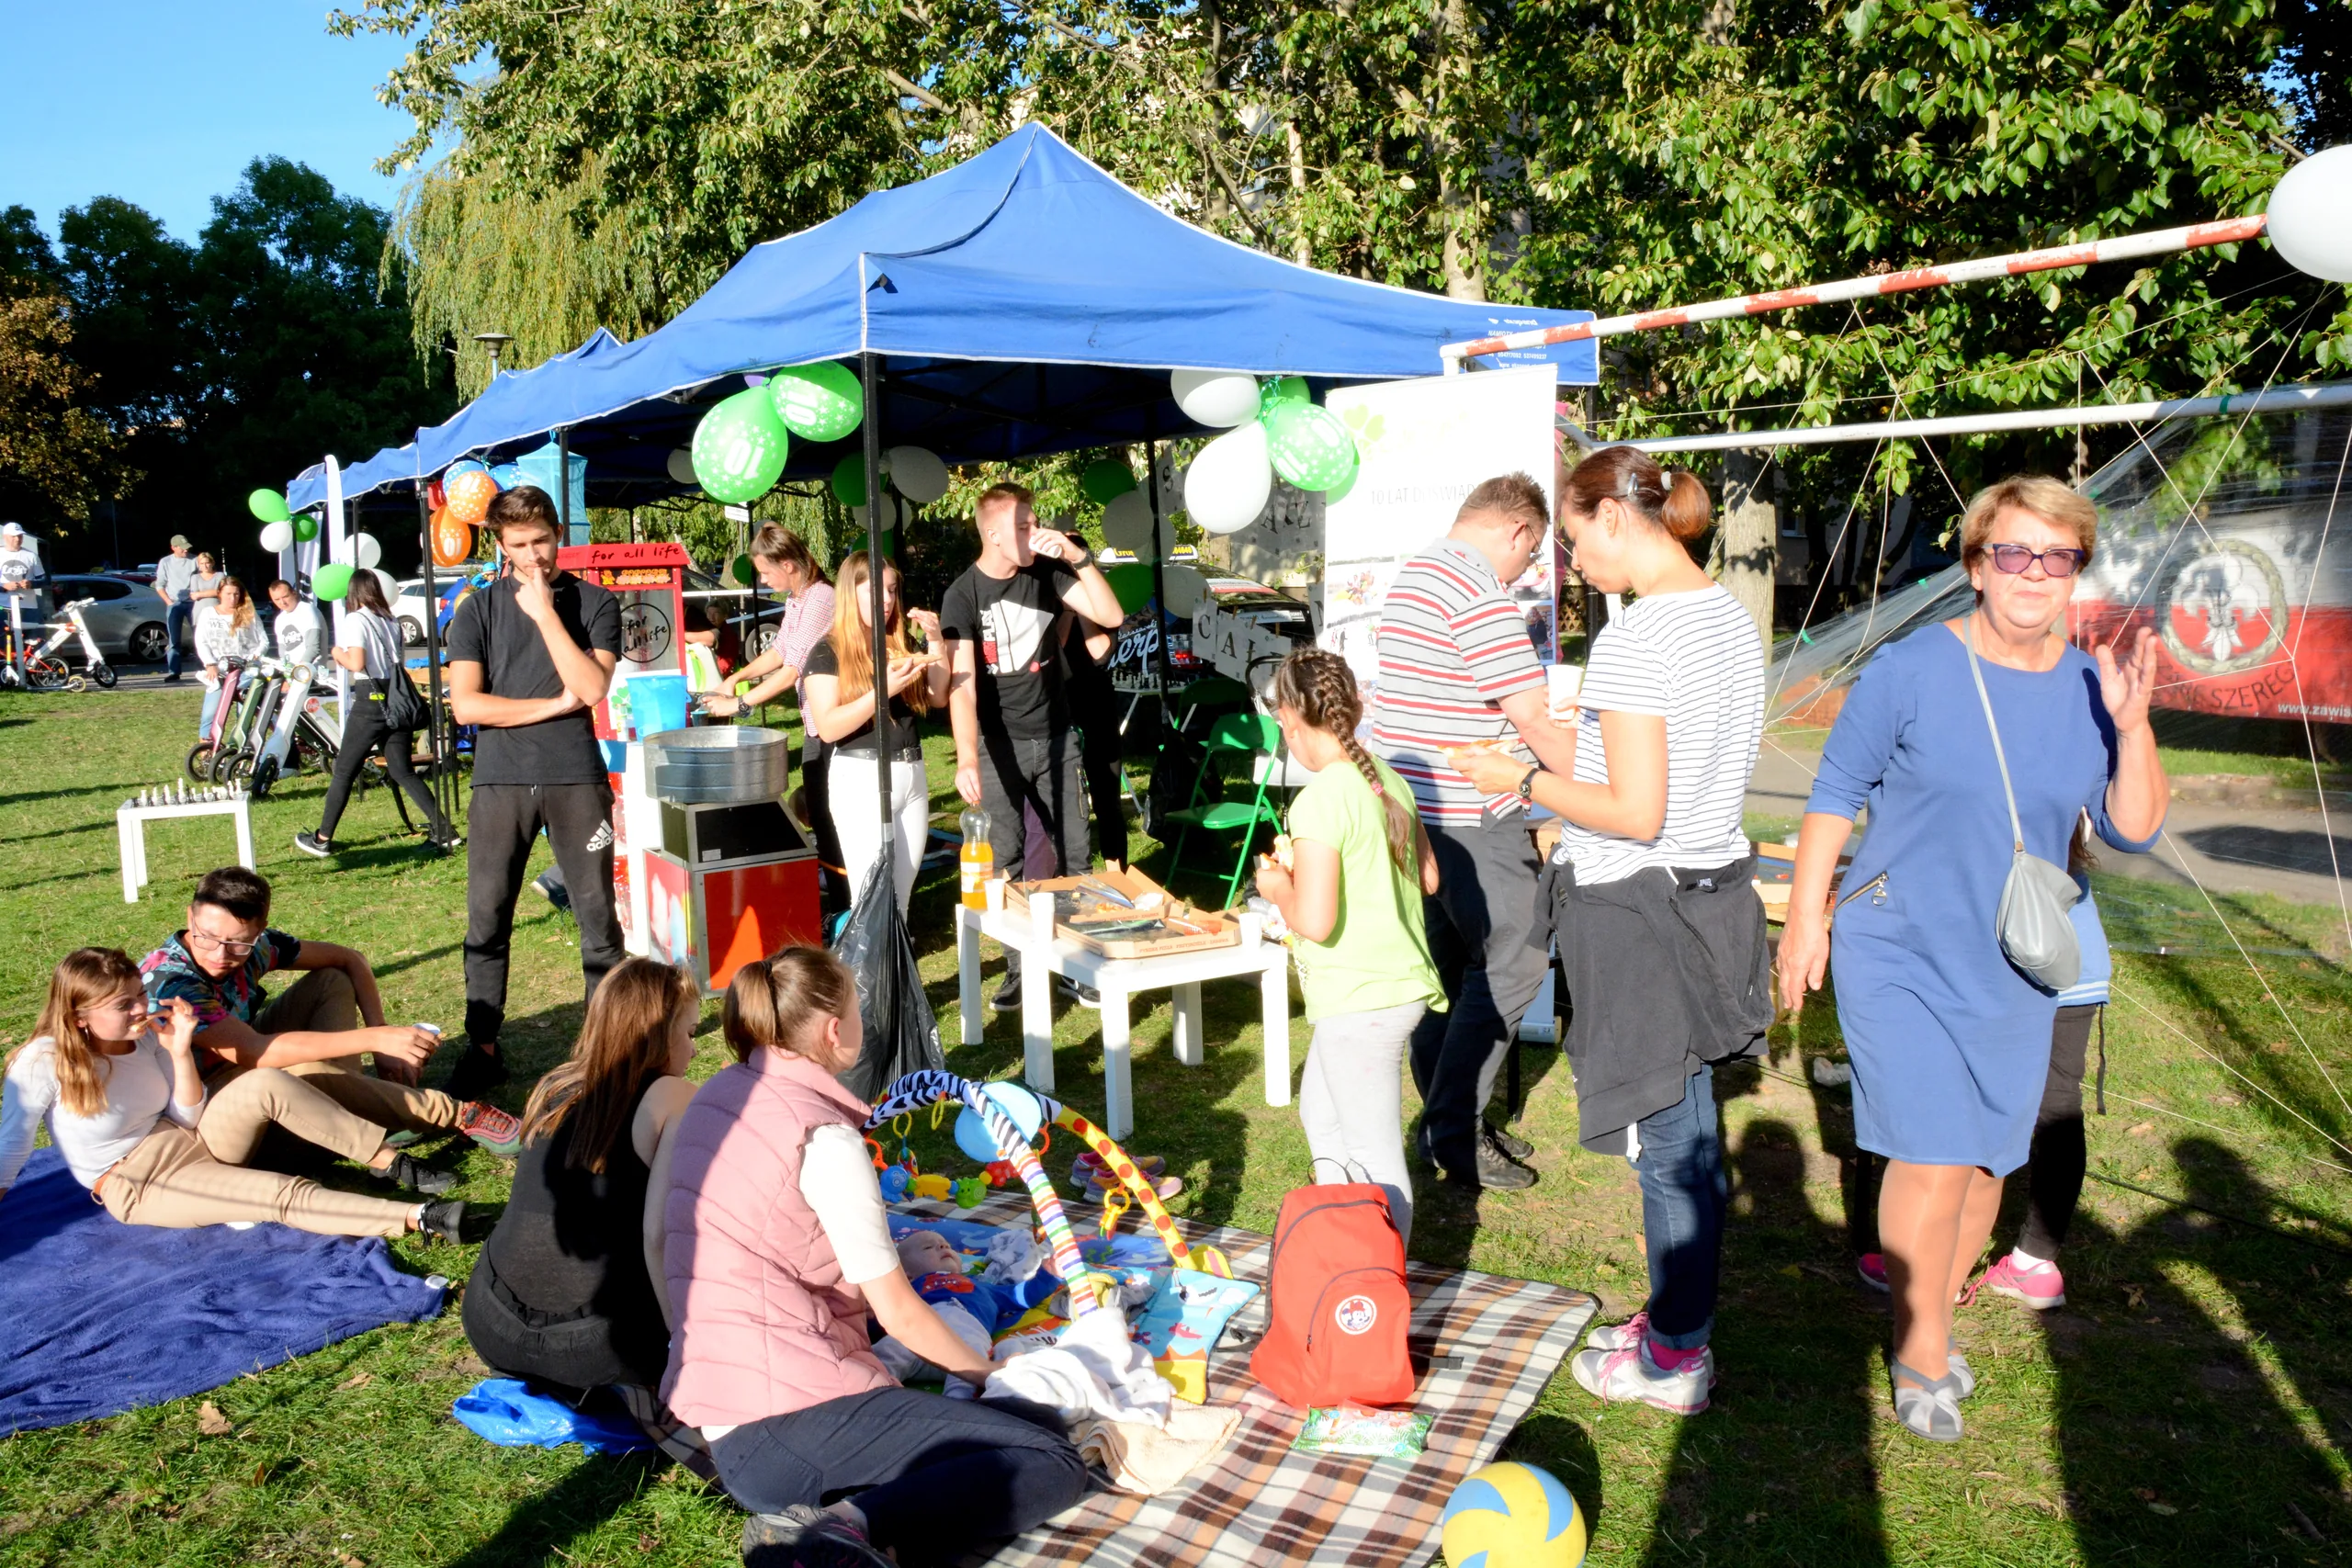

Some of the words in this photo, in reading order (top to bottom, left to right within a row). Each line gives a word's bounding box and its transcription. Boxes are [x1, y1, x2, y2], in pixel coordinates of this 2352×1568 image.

[1387, 487, 1408, 504] LAT
[592, 550, 615, 563] for
[624, 547, 644, 558] all
[653, 545, 680, 558] life
[627, 615, 648, 635] for
[623, 637, 642, 654] all
[644, 626, 667, 645] life
